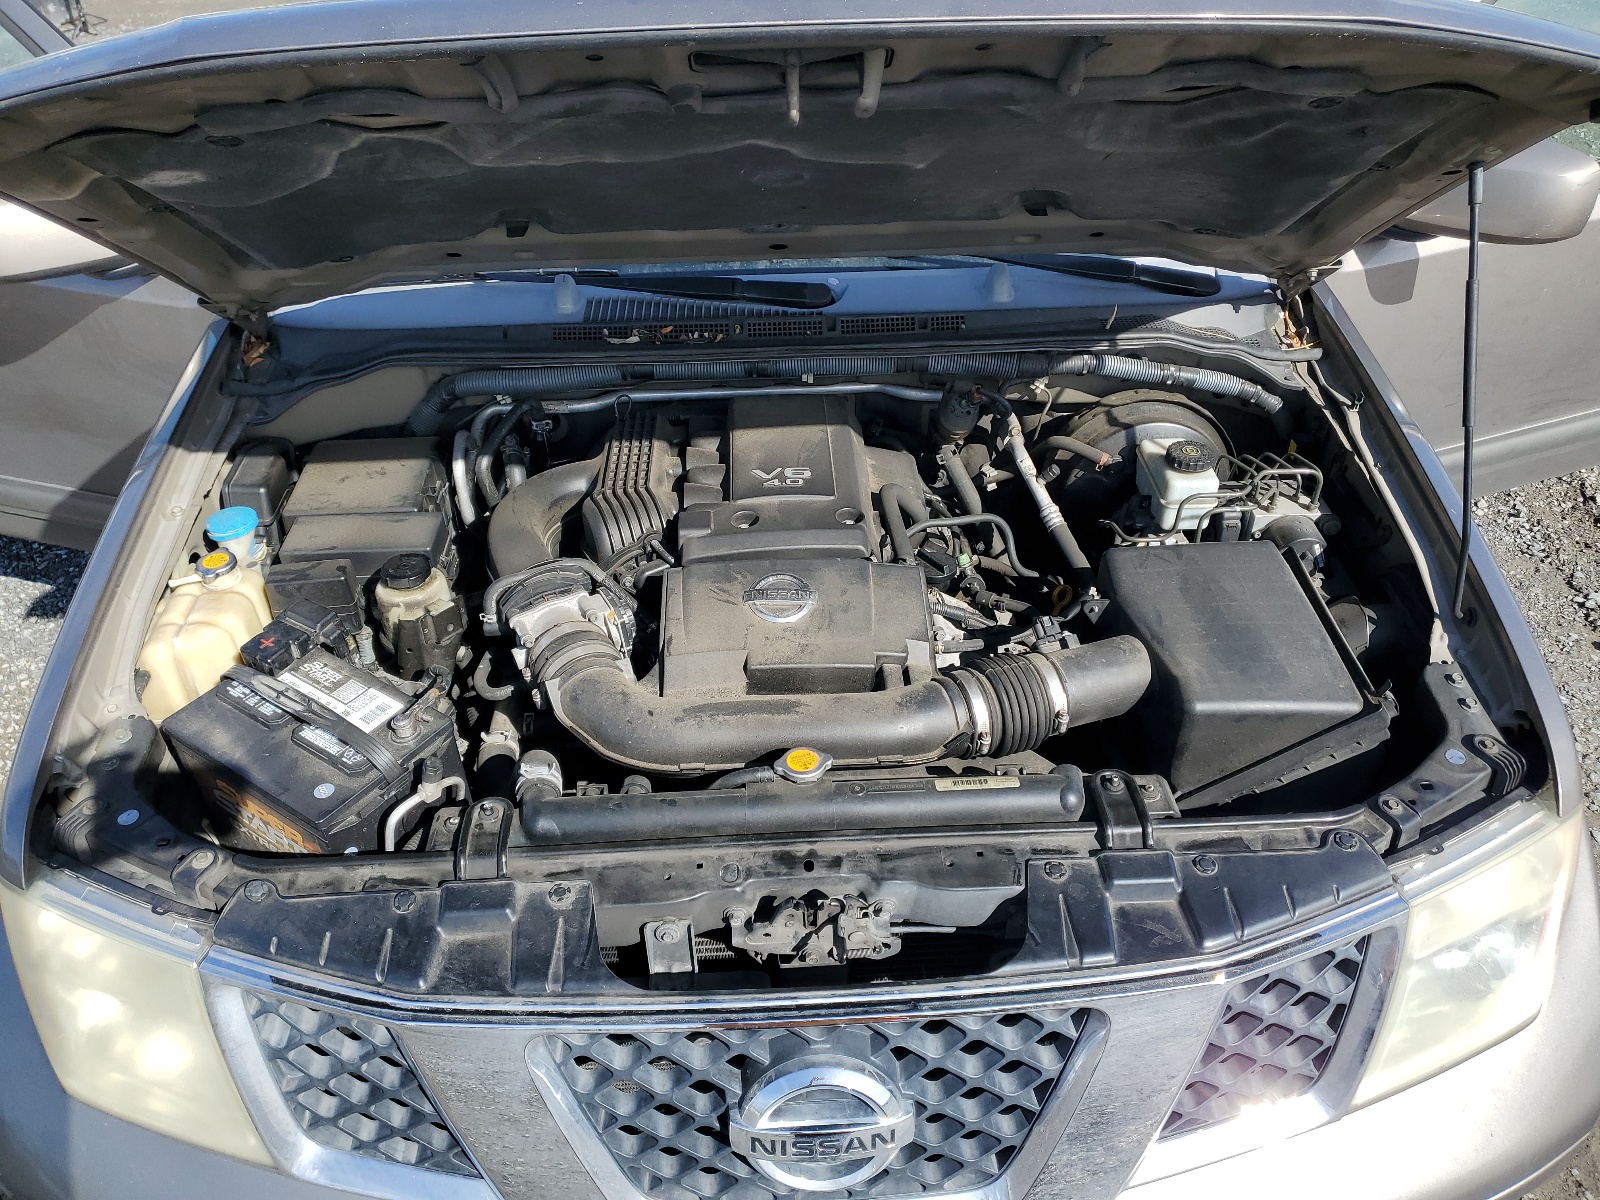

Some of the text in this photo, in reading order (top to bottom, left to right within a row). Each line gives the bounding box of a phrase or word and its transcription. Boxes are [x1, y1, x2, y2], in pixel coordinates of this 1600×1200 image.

[750, 467, 812, 479] V6
[761, 478, 805, 487] 4.0
[751, 590, 810, 600] NISSAN
[216, 779, 305, 848] SUPER
[750, 1128, 896, 1158] NISSAN
